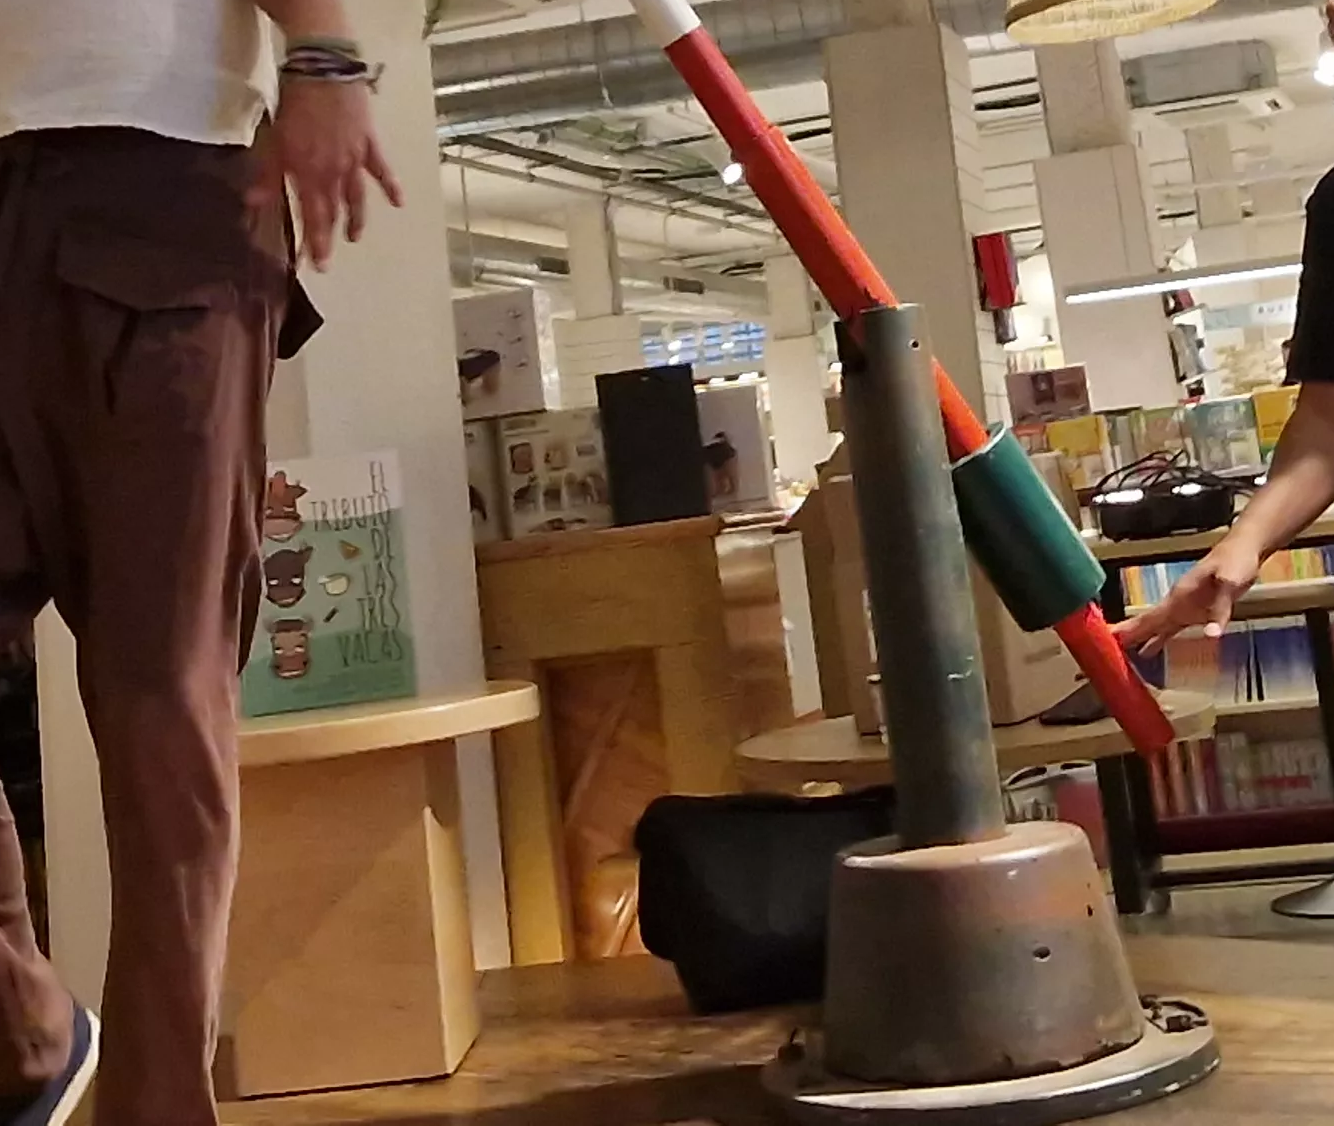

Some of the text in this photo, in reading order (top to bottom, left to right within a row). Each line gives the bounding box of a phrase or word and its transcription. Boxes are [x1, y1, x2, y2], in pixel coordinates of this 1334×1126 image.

[369, 460, 389, 494] EL
[310, 494, 392, 532] TRIBUTO
[371, 527, 393, 561] DE
[362, 559, 398, 597] LAS
[356, 593, 401, 630] TRES
